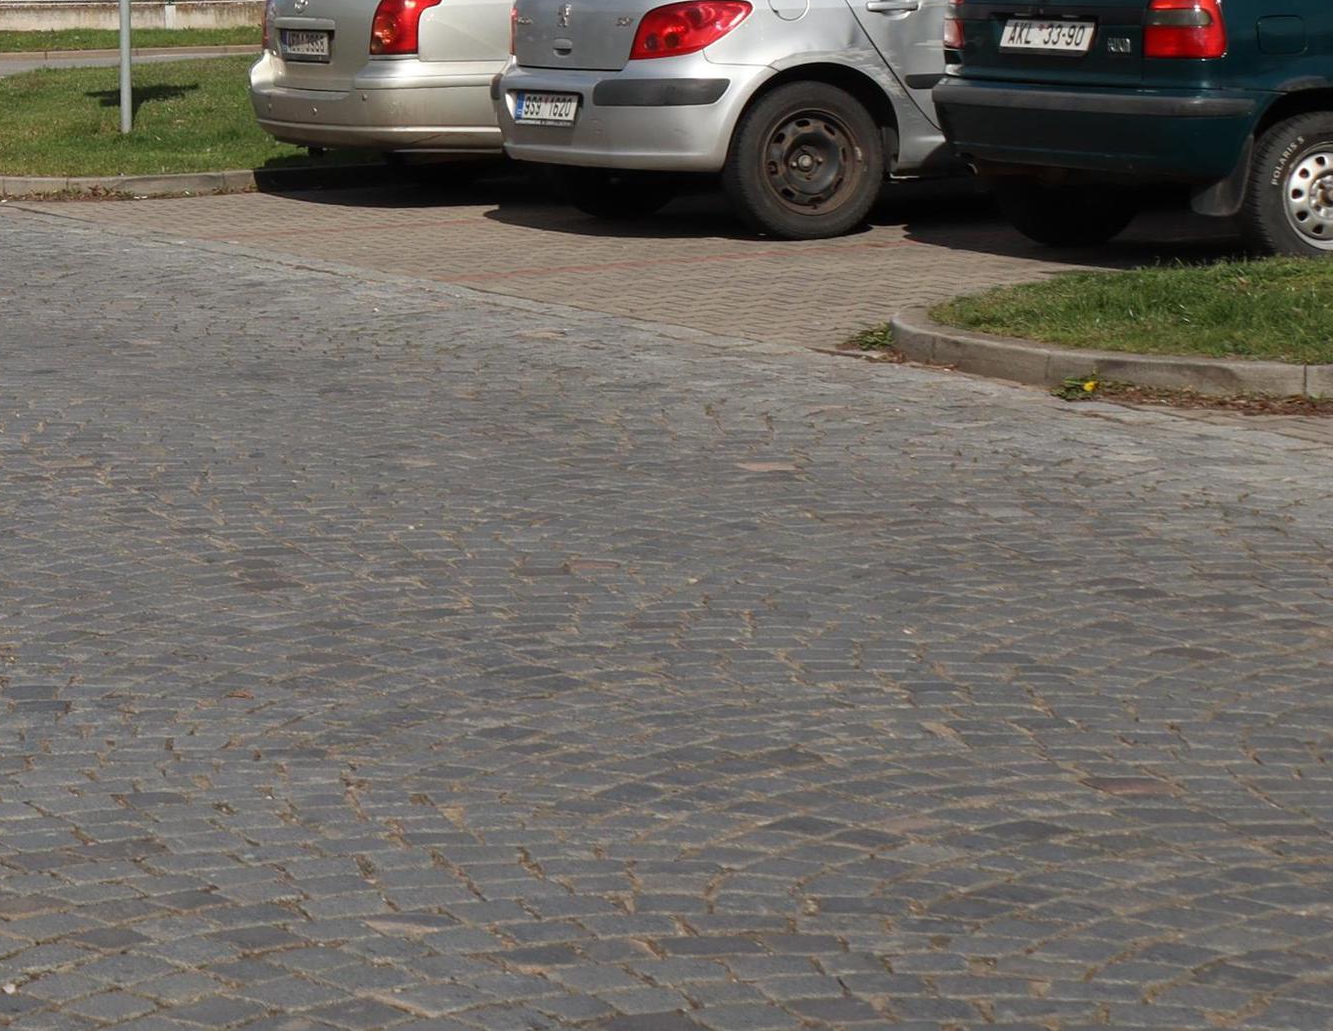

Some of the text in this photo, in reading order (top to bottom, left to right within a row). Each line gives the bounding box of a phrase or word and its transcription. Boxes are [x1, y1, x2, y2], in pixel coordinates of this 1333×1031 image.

[1008, 22, 1033, 45] AKL
[548, 97, 572, 117] 1620
[1270, 142, 1298, 186] POLARIS
